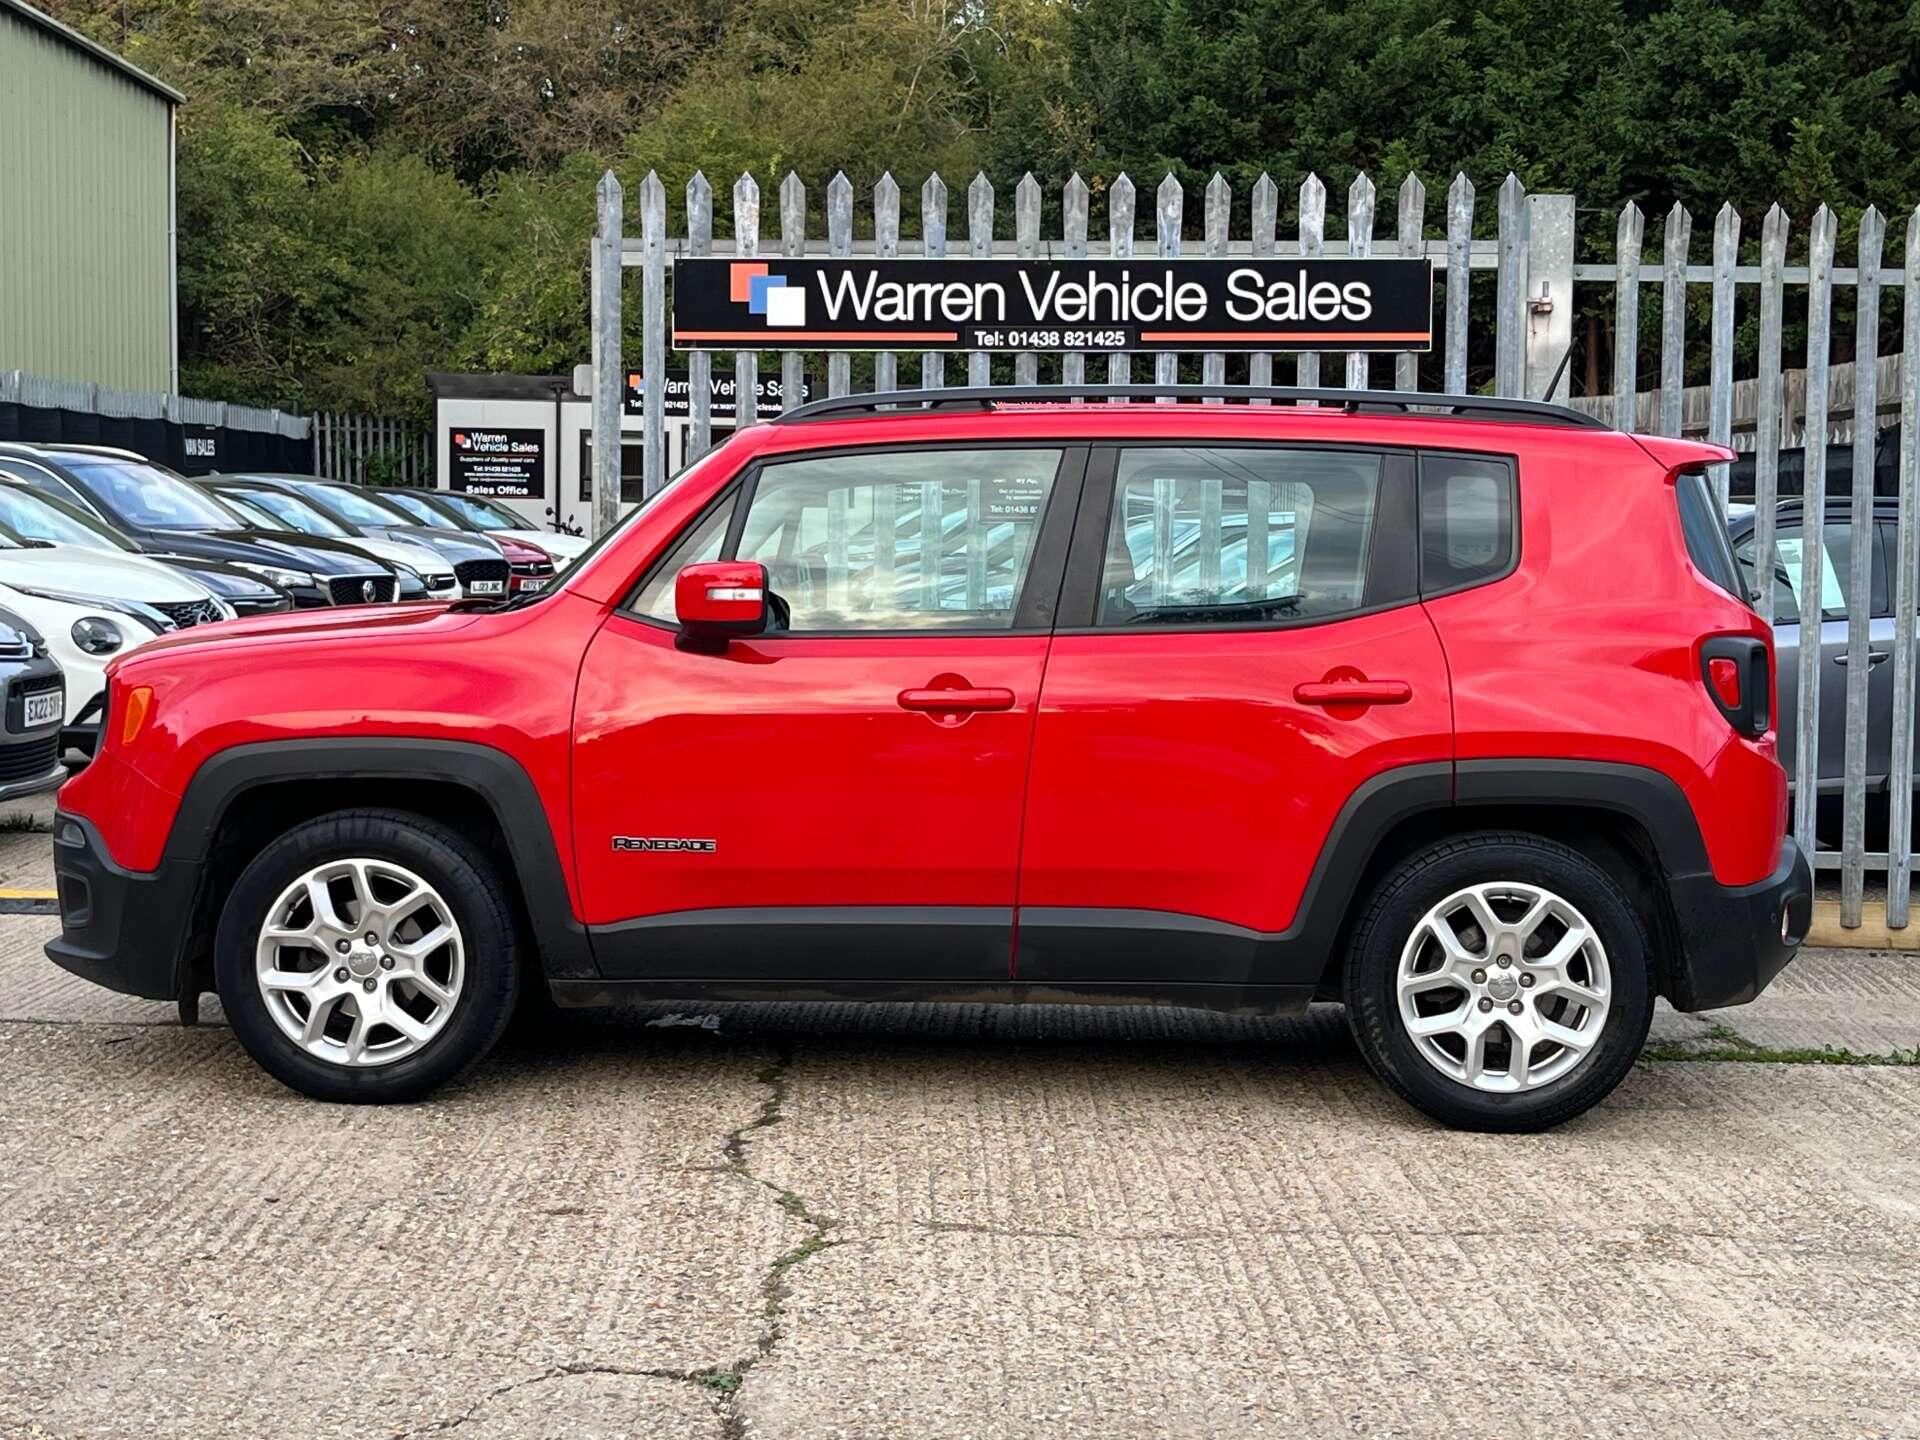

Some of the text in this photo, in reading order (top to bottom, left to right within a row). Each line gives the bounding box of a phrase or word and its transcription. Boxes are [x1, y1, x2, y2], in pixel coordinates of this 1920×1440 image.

[817, 268, 1372, 322] Warren Vehicle Sales
[974, 331, 1125, 347] Tel: 01438 821425
[710, 379, 764, 396] Vehe
[766, 380, 808, 397] Sas
[471, 432, 507, 443] Warren
[473, 441, 539, 453] Vehicle Sales
[466, 485, 529, 495] Sales Office
[612, 836, 717, 852] RENEGADE
